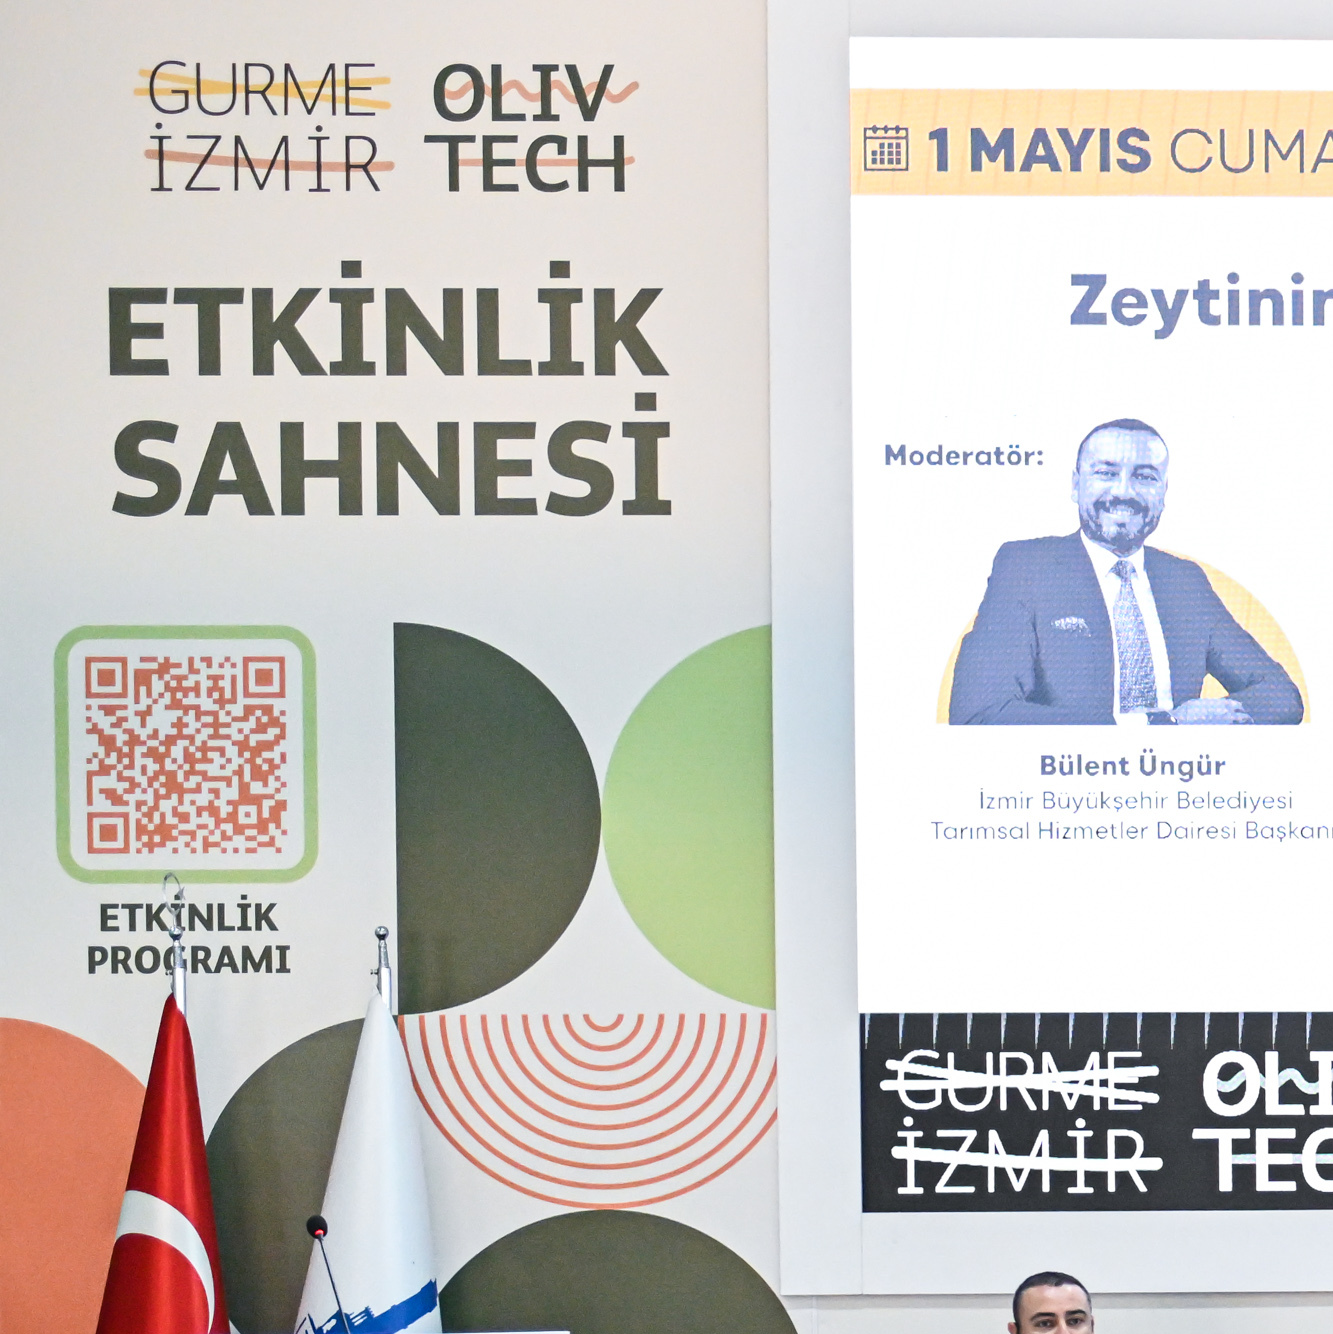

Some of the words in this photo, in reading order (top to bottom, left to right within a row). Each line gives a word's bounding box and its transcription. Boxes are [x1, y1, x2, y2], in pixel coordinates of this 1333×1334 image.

[149, 60, 375, 117] GURME
[433, 63, 615, 122] OLIV
[150, 122, 380, 192] İZMİR
[424, 135, 626, 193] TECH
[928, 127, 949, 172] 1
[970, 127, 1152, 173] MAYIS
[108, 260, 669, 377] ETKİNLİK
[111, 392, 672, 517] SAHNESİ
[884, 444, 1043, 467] Moderatör:
[1040, 754, 1129, 776] Bülent
[1139, 749, 1225, 782] Üngür
[980, 788, 1033, 810] İzmir
[1042, 790, 1168, 814] Büyükşehir
[1177, 790, 1292, 813] Belediyesi
[931, 821, 1029, 840] Tarımsal
[1039, 821, 1148, 840] Hizmetler
[1157, 821, 1236, 840] Dairesi
[100, 894, 279, 932] ETKİNLİK
[897, 1049, 1143, 1111] GURME
[897, 1116, 1147, 1195] İZMİR
